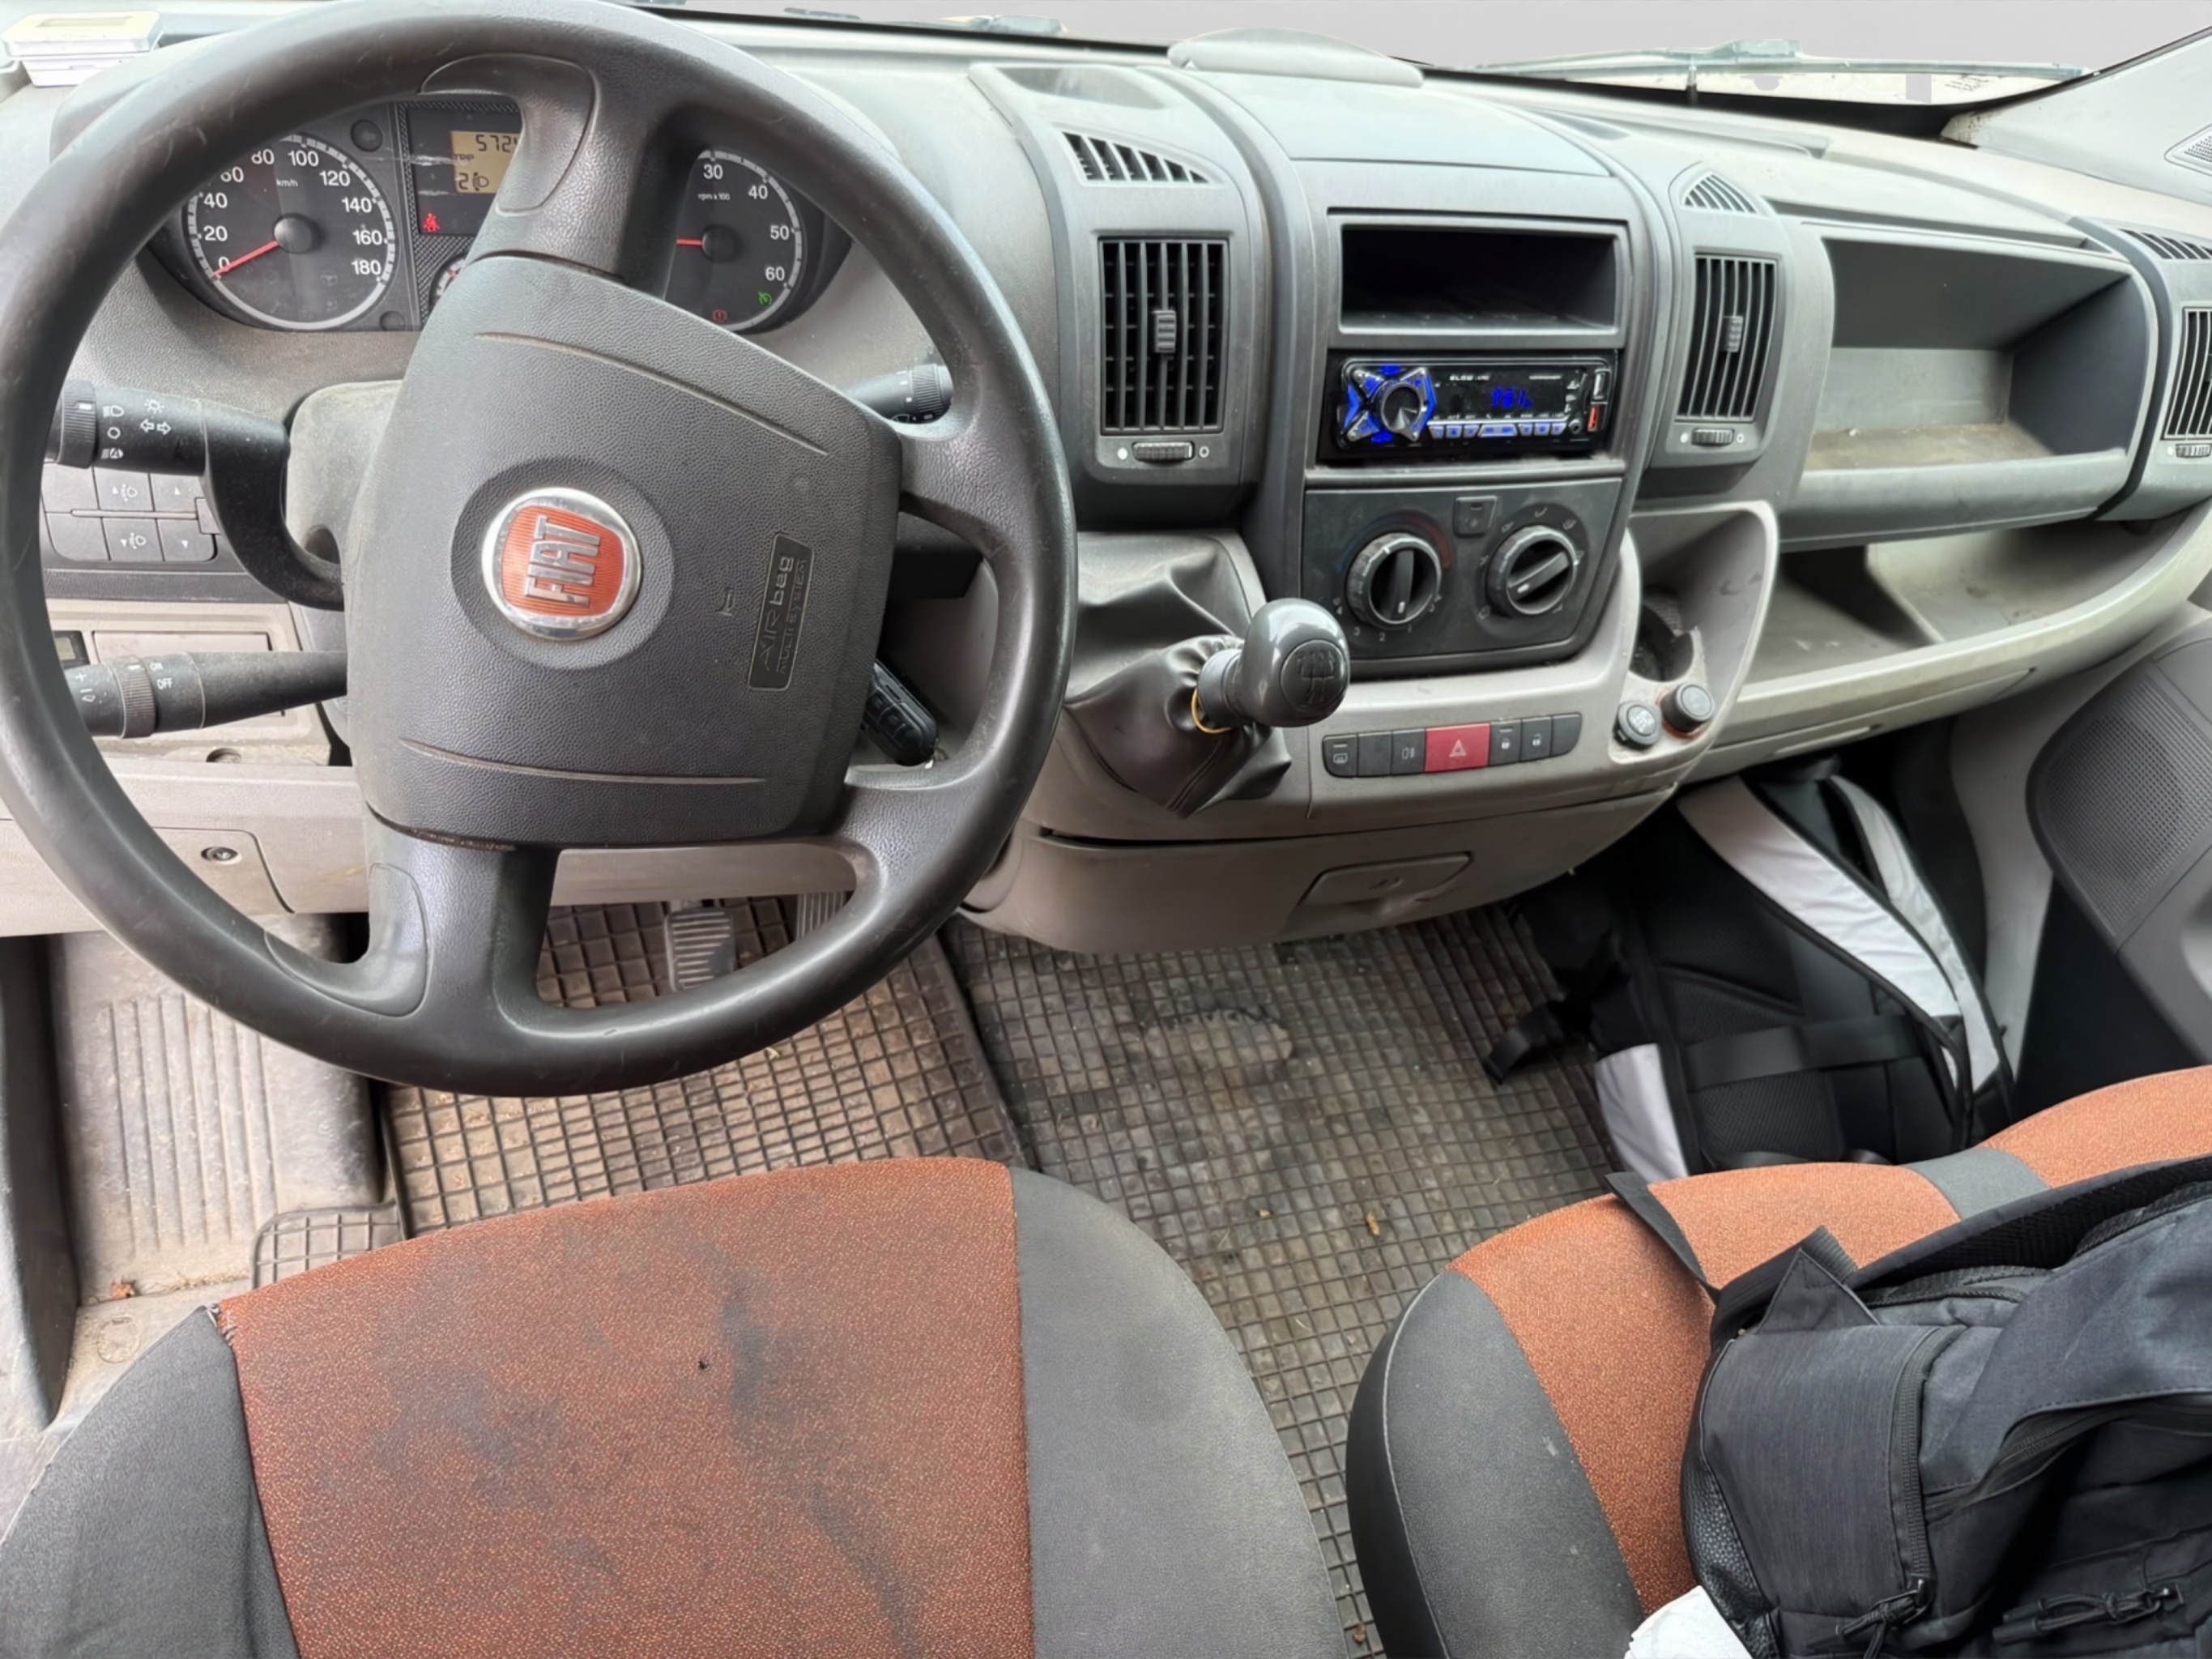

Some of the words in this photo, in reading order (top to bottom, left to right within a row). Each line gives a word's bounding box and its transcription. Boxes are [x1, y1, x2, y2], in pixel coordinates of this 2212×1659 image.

[288, 150, 319, 167] 100
[319, 170, 351, 186] 120
[703, 164, 723, 179] 30
[276, 178, 298, 187] km/h
[458, 172, 469, 190] 2
[203, 192, 228, 208] 40
[748, 186, 768, 199] 40
[341, 197, 372, 213] 140
[203, 226, 228, 241] 20
[352, 230, 382, 245] 160
[770, 225, 790, 240] 50
[218, 256, 230, 271] 0
[351, 259, 381, 275] 180
[765, 266, 785, 281] 60
[523, 514, 600, 608] FIAT
[1353, 626, 1361, 637] 3
[1379, 632, 1386, 642] 2
[156, 677, 173, 690] OFF
